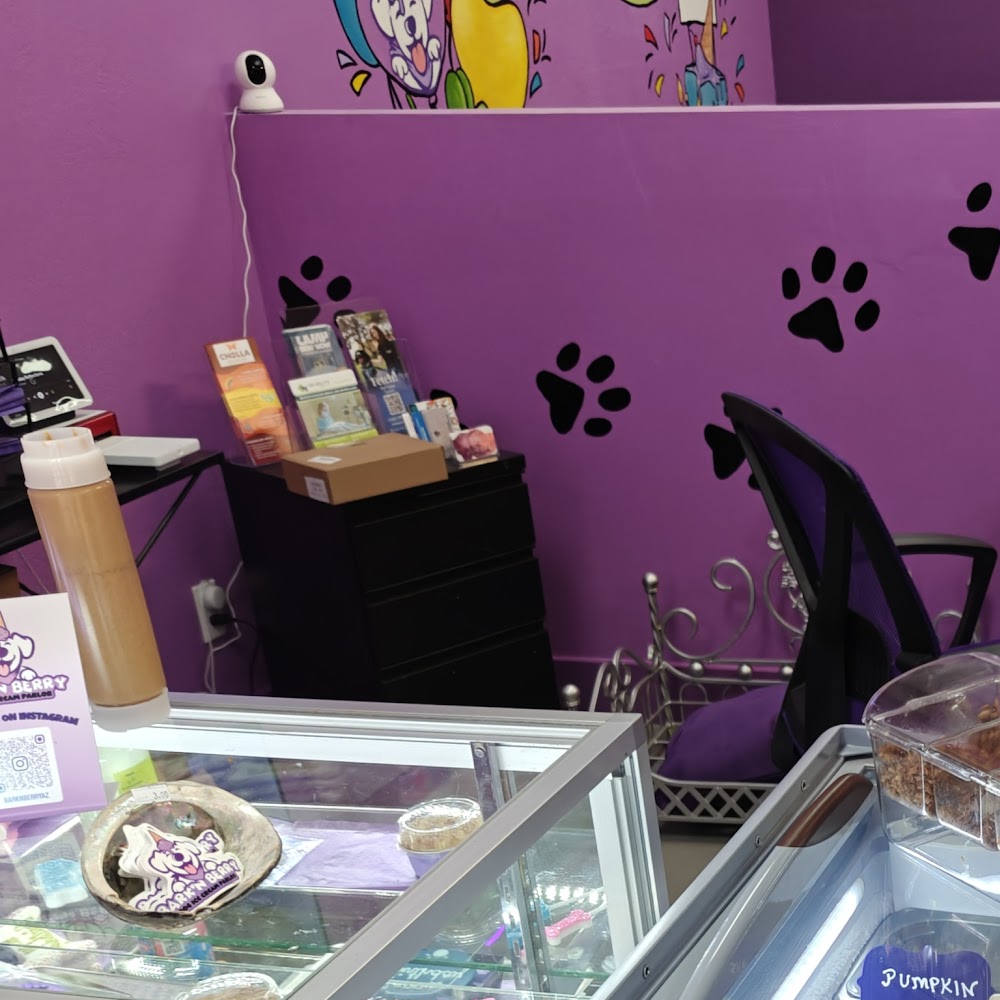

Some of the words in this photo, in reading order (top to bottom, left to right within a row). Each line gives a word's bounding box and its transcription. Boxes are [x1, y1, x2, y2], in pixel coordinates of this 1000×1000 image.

[219, 349, 251, 361] CHOLLA
[11, 676, 68, 693] BERRY
[21, 690, 53, 700] PARLOR
[1, 712, 17, 721] ON
[18, 712, 79, 726] INSTAGRAM
[4, 792, 50, 803] BARKNBERRYAZ
[204, 860, 240, 884] BERRY
[200, 884, 220, 898] CREAM
[881, 967, 979, 998] PUMPKIN
